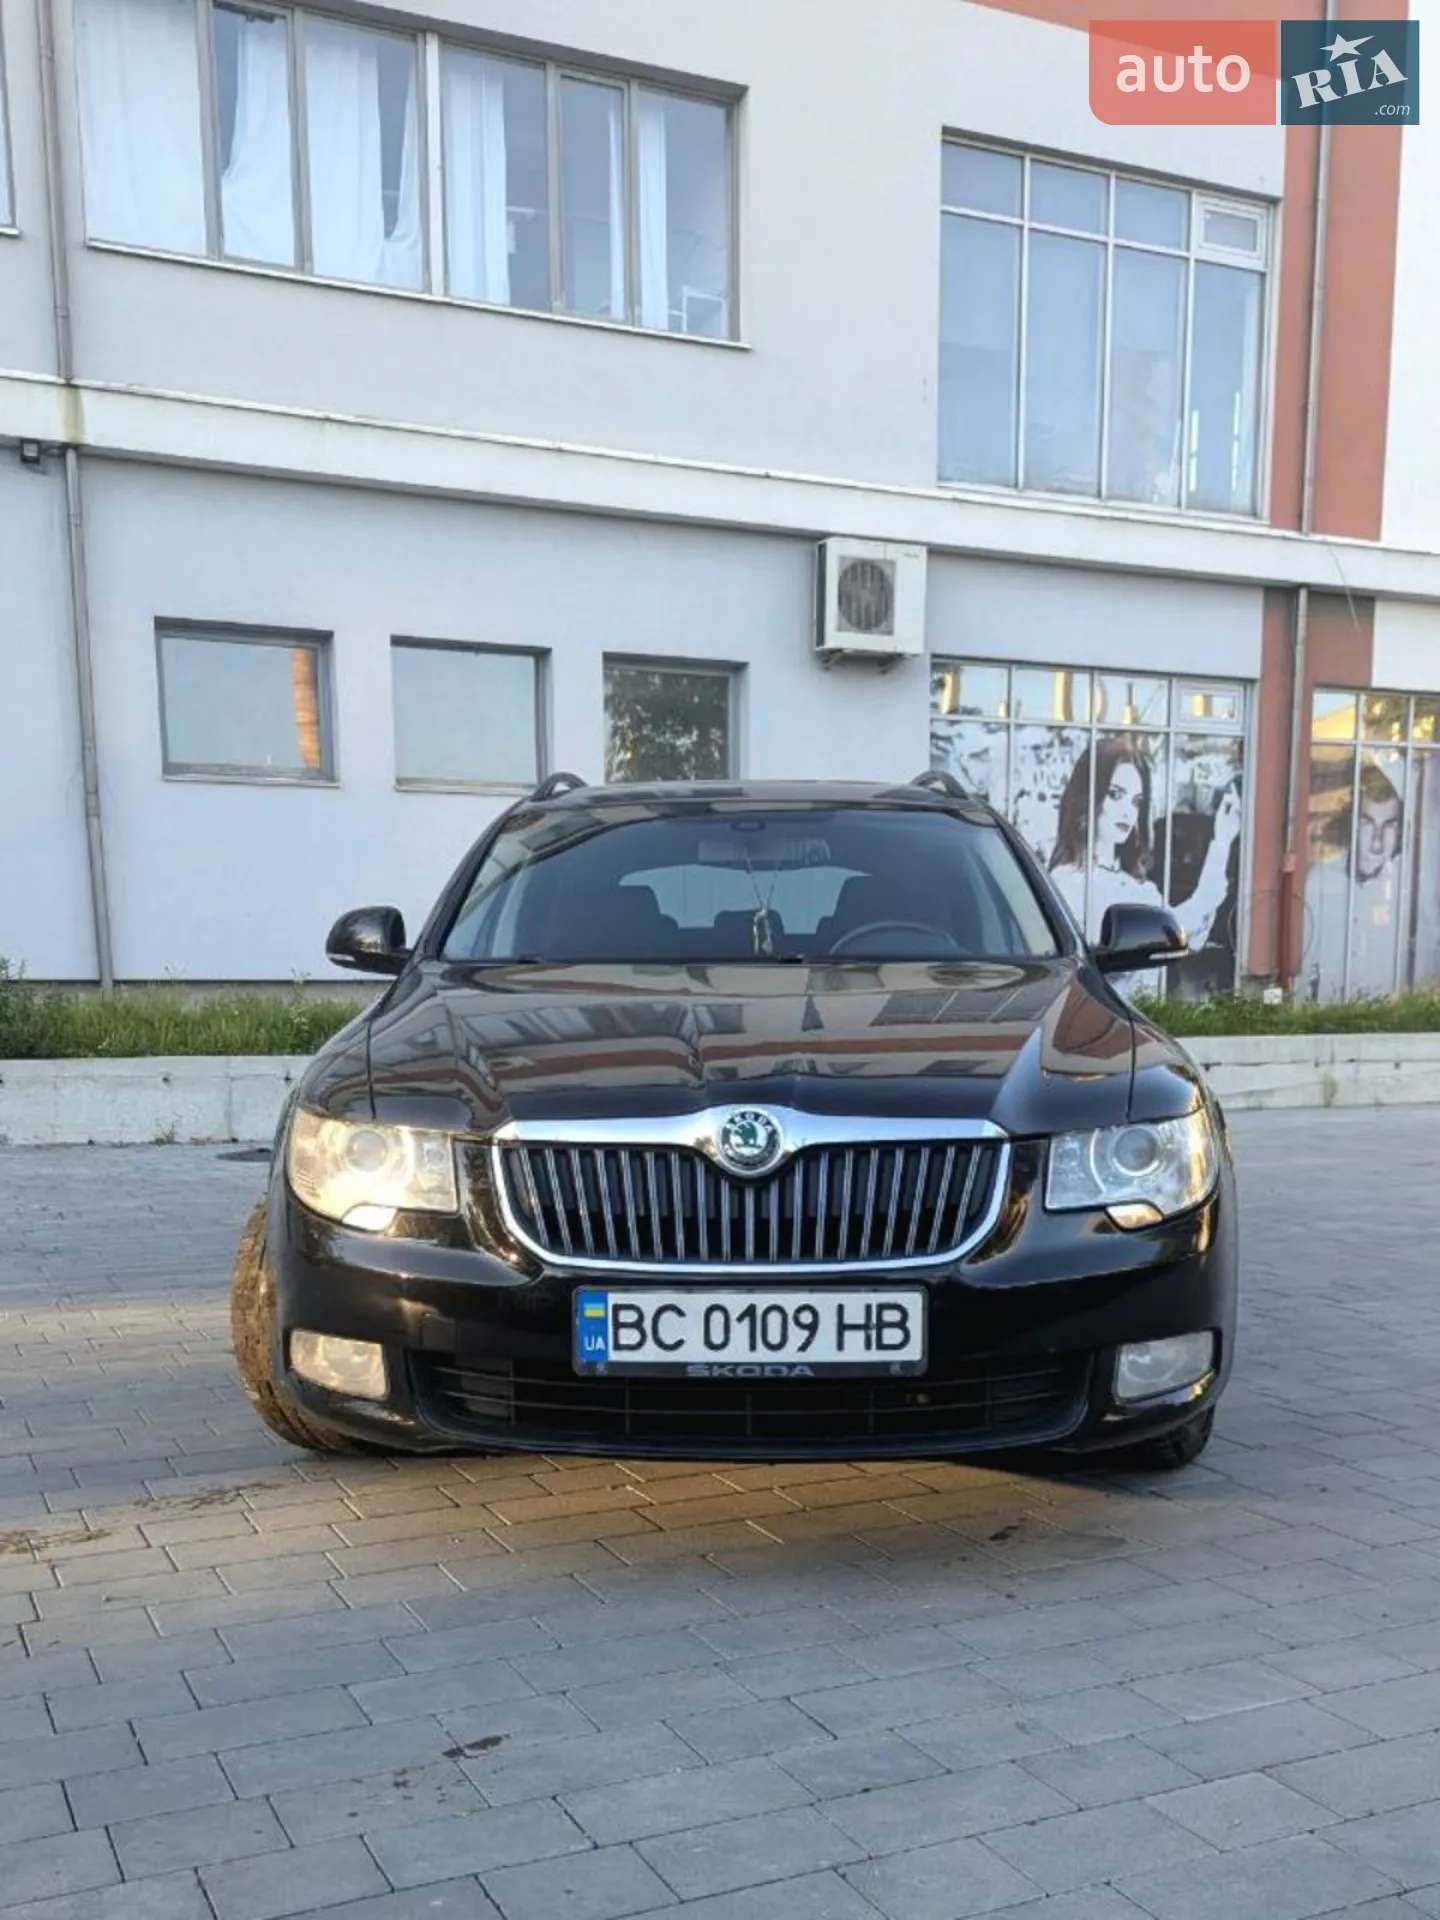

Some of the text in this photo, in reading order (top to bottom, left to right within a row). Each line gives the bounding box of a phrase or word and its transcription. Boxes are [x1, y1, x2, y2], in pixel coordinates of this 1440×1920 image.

[612, 1303, 911, 1351] BC 0109 HB
[584, 1336, 606, 1351] UA
